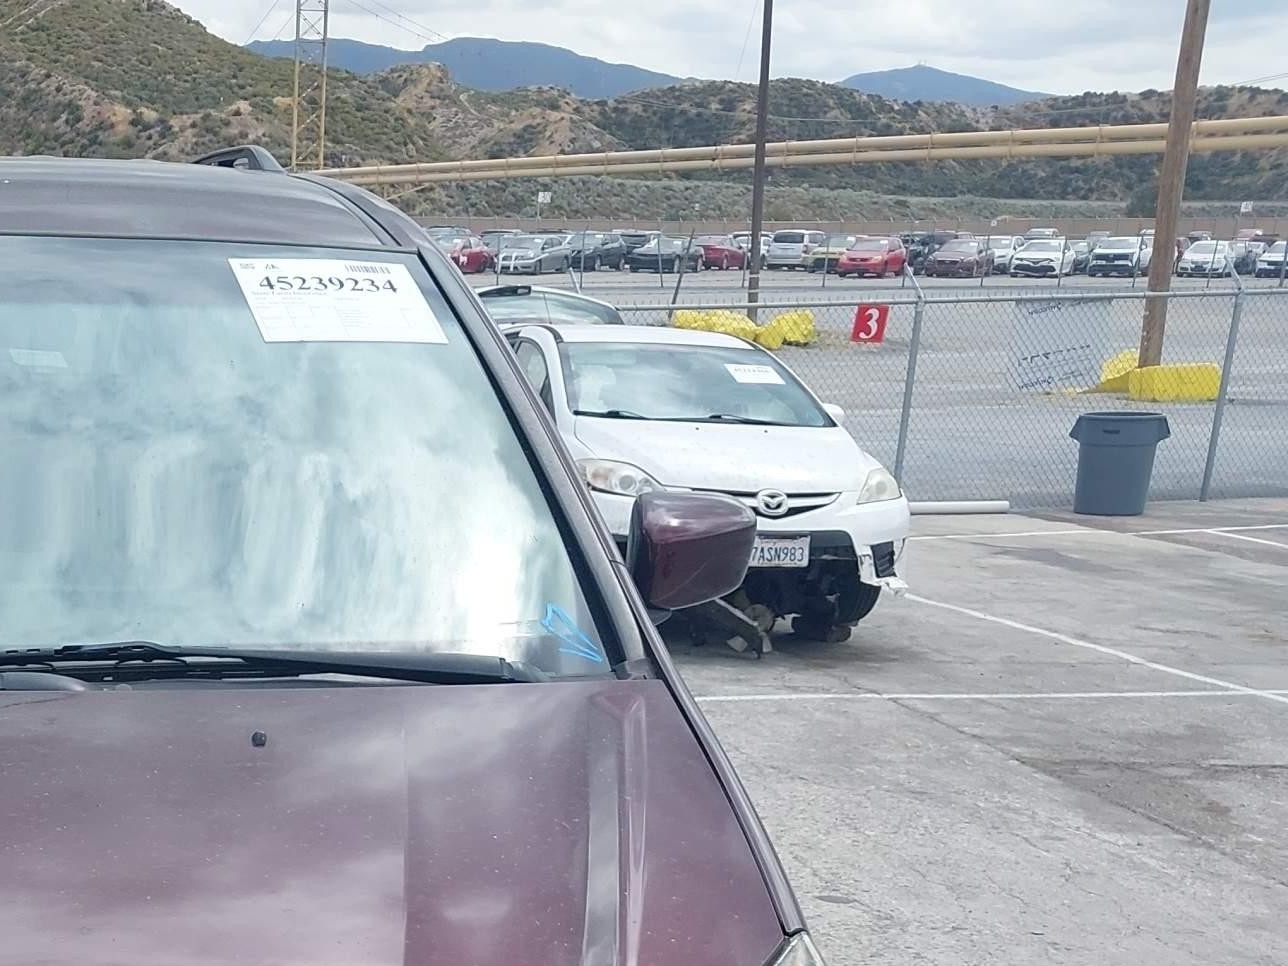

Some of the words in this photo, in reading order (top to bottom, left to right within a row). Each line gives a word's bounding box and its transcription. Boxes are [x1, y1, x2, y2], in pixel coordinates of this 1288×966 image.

[259, 276, 397, 293] 45239234
[858, 308, 880, 339] 3
[752, 546, 805, 562] 7ASN983
